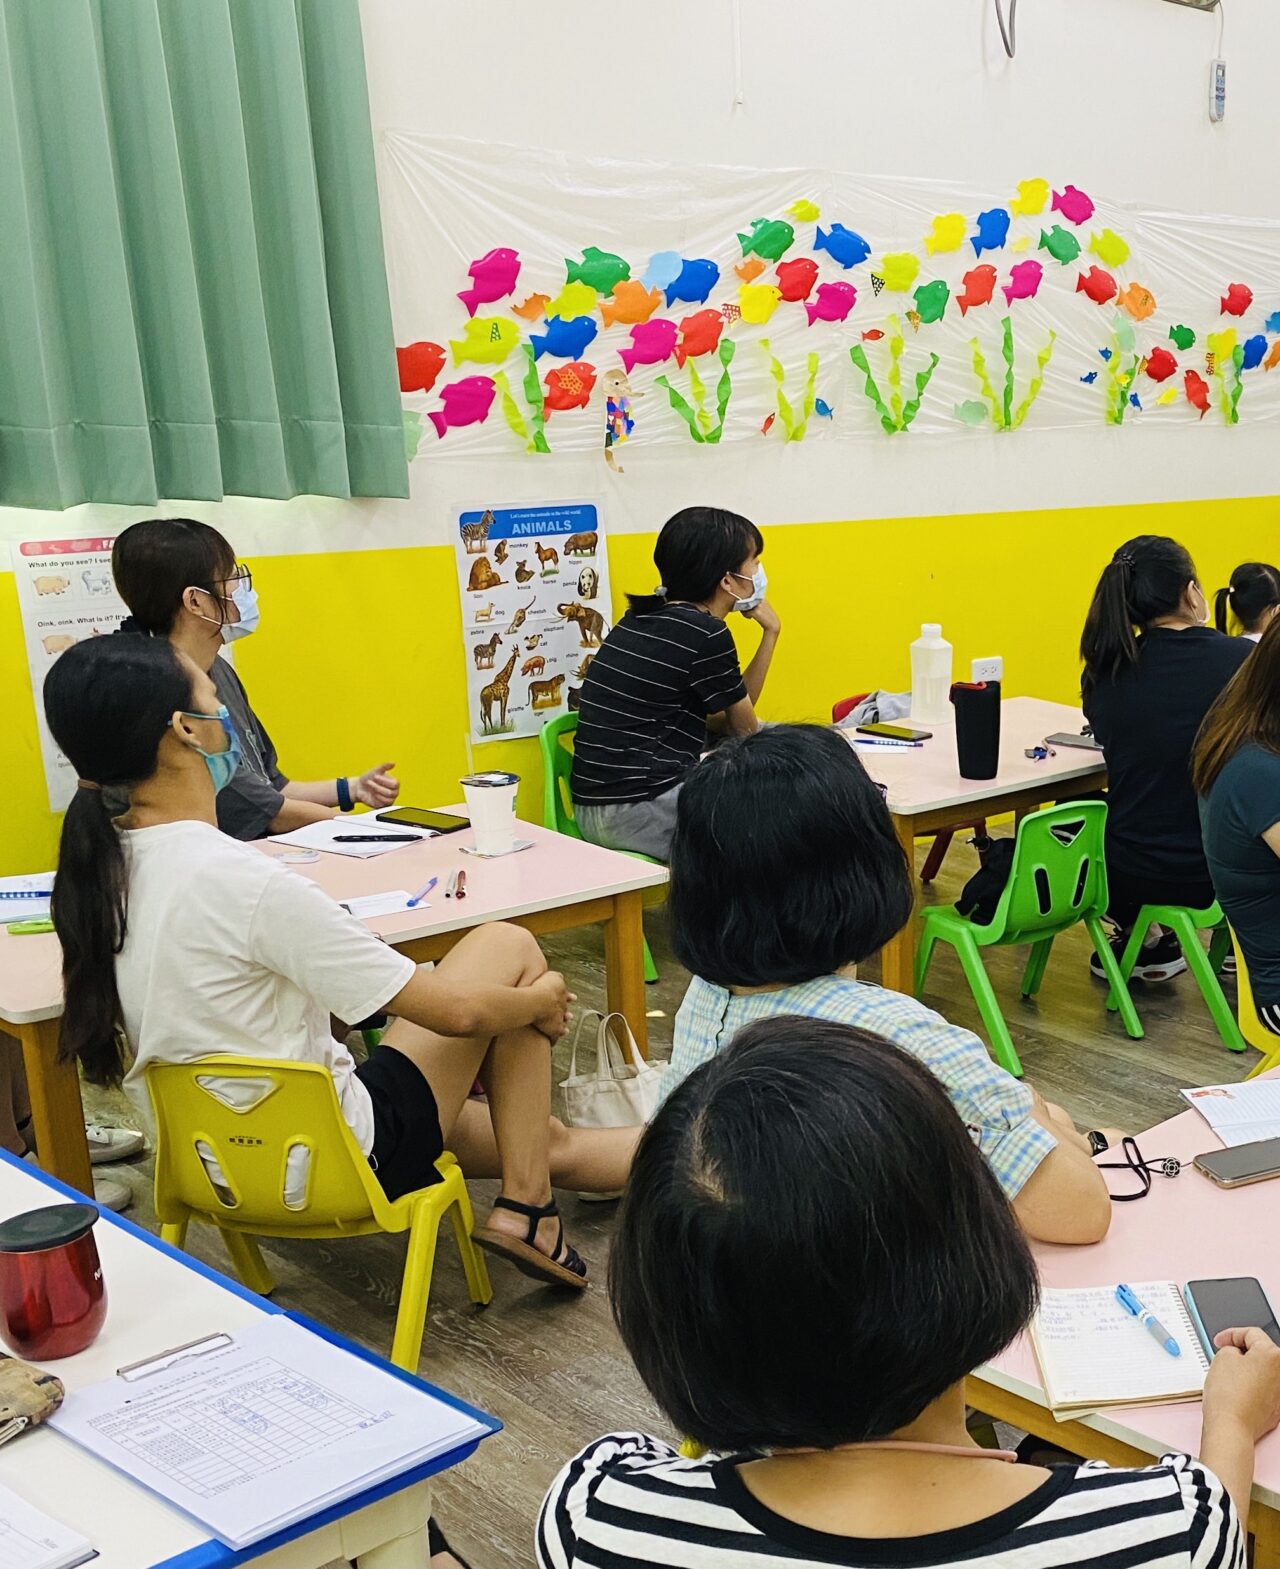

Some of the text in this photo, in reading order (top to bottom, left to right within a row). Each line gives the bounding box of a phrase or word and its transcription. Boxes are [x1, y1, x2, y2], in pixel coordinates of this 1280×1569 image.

[511, 519, 572, 535] ANIMALS
[28, 561, 47, 569] What
[77, 616, 95, 624] What
